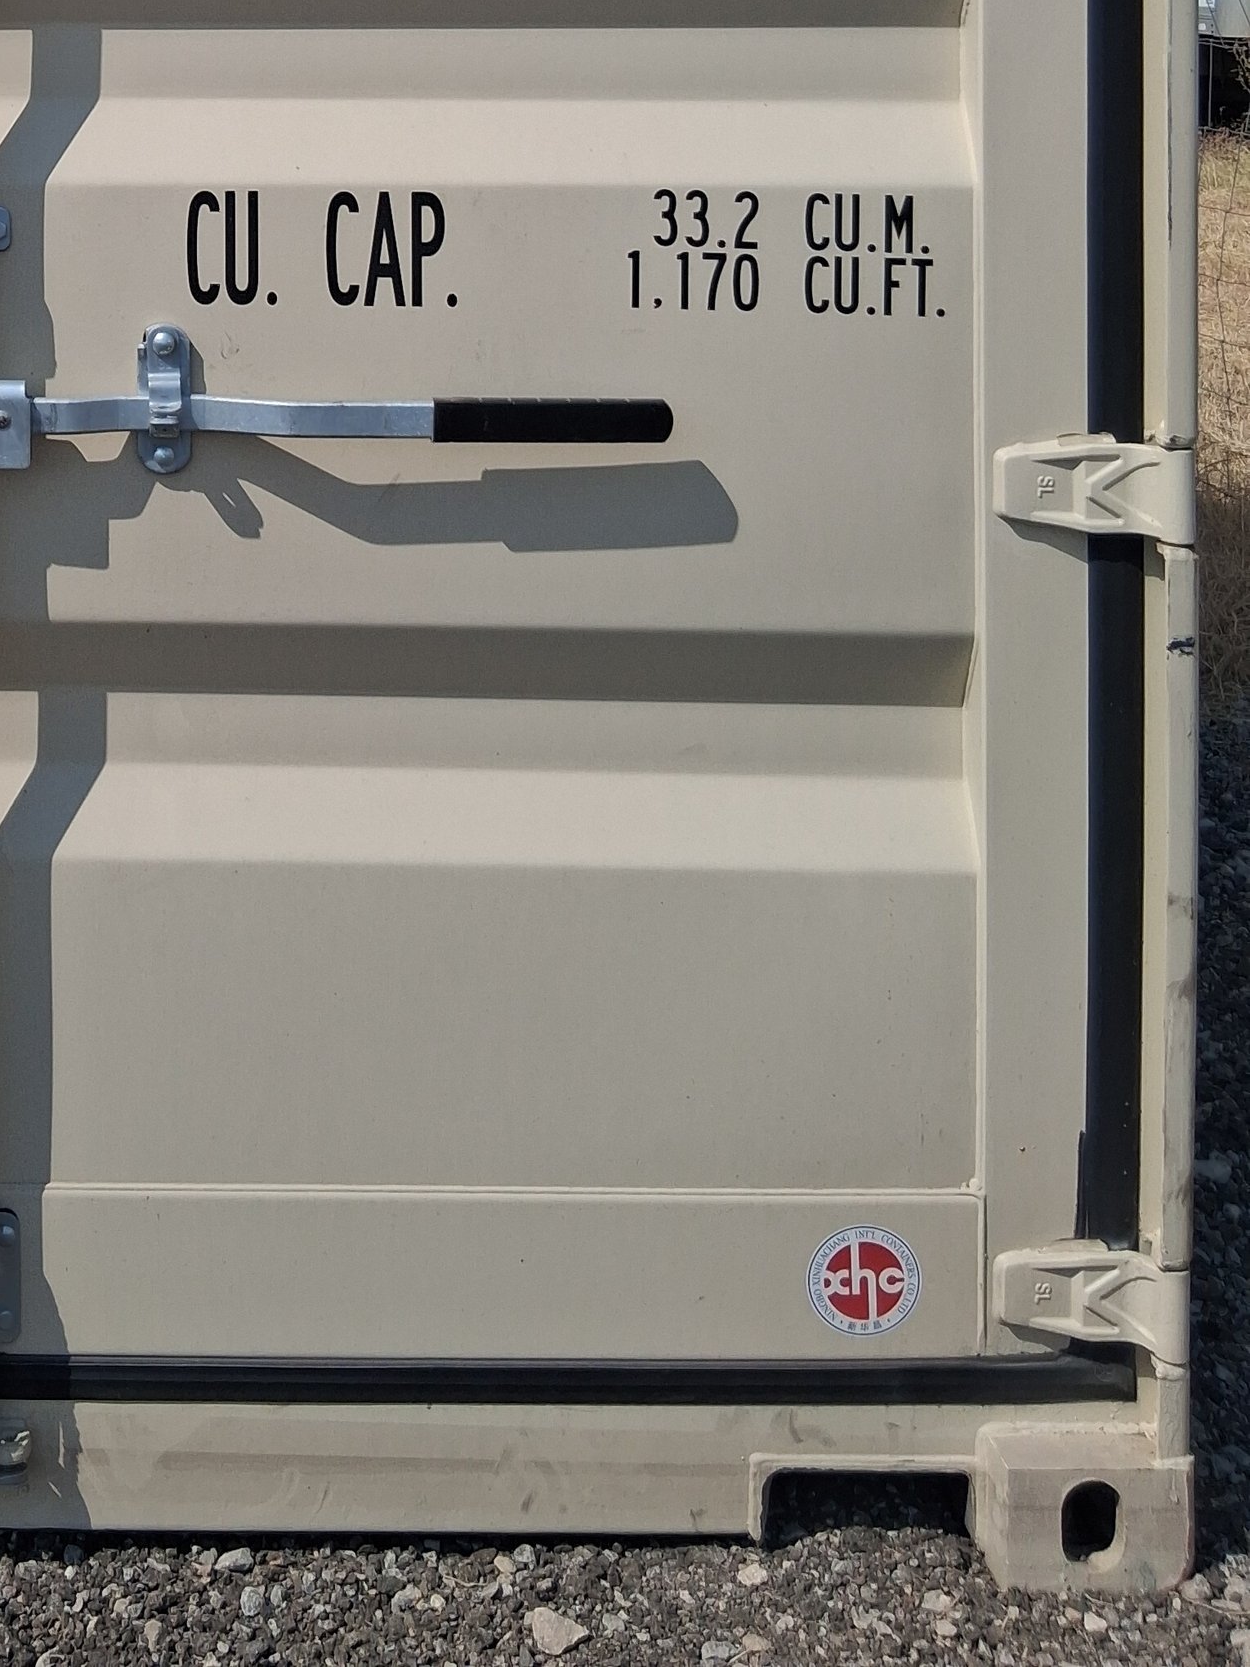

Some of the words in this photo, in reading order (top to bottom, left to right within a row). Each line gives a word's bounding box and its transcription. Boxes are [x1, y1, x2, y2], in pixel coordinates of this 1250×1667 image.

[186, 190, 278, 306] CU.
[325, 191, 458, 308] CAP.
[653, 188, 759, 250] 33.2
[805, 192, 930, 255] CU.M.
[627, 250, 760, 312] 1,170
[804, 255, 946, 317] CU.FT.
[1037, 475, 1055, 499] SL
[1035, 1282, 1052, 1305] SL
